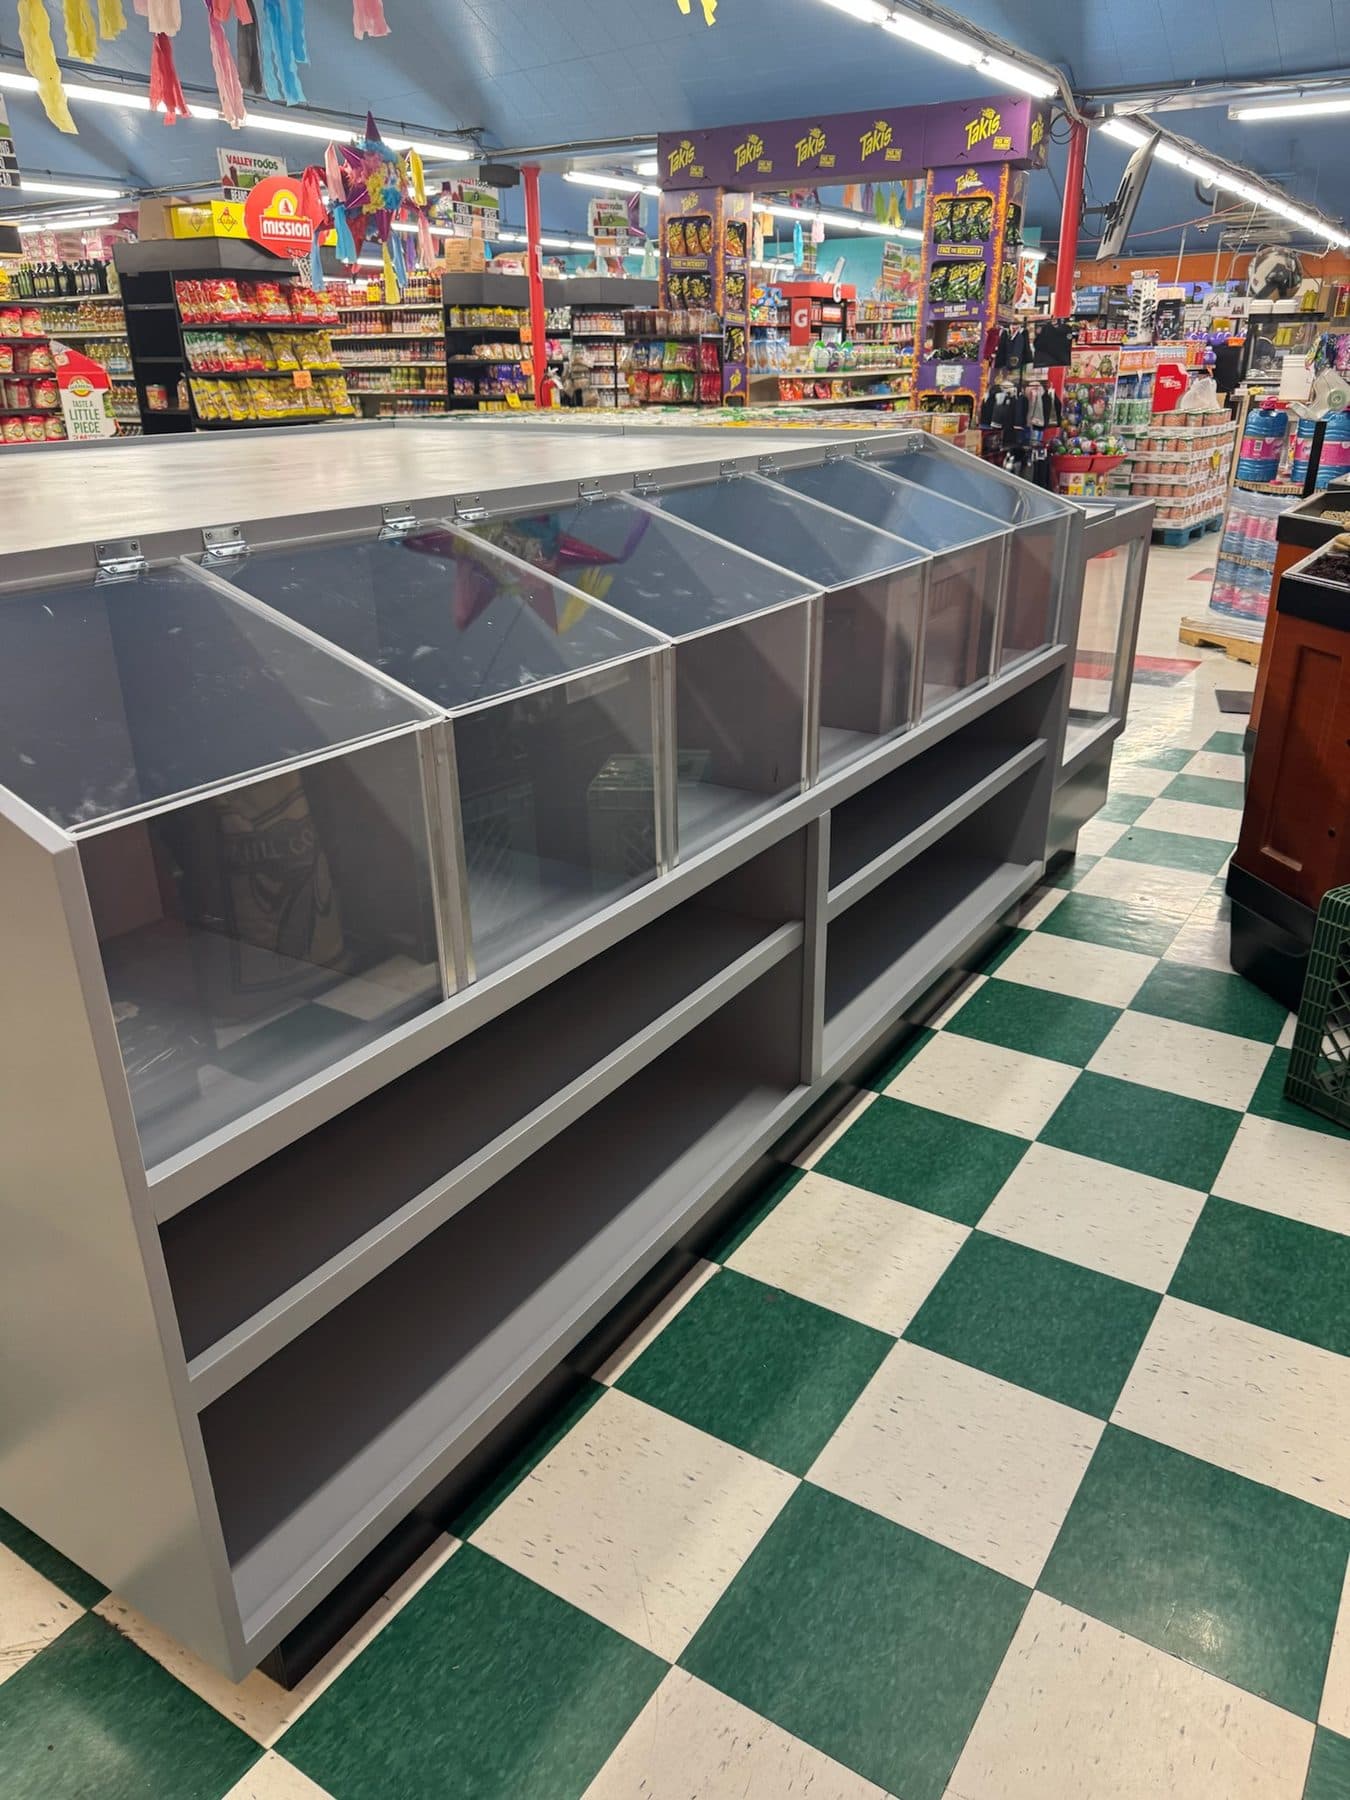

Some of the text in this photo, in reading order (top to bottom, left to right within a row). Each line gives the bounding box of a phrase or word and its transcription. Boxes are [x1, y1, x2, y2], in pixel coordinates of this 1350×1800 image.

[860, 127, 893, 162] Takis
[965, 114, 1001, 151] Takis
[668, 146, 695, 177] Takis
[734, 140, 764, 172] Takis
[795, 133, 826, 167] Takis
[794, 309, 808, 328] G
[69, 409, 100, 421] LITTLE
[72, 400, 89, 408] TASTE
[74, 421, 100, 434] PIECE
